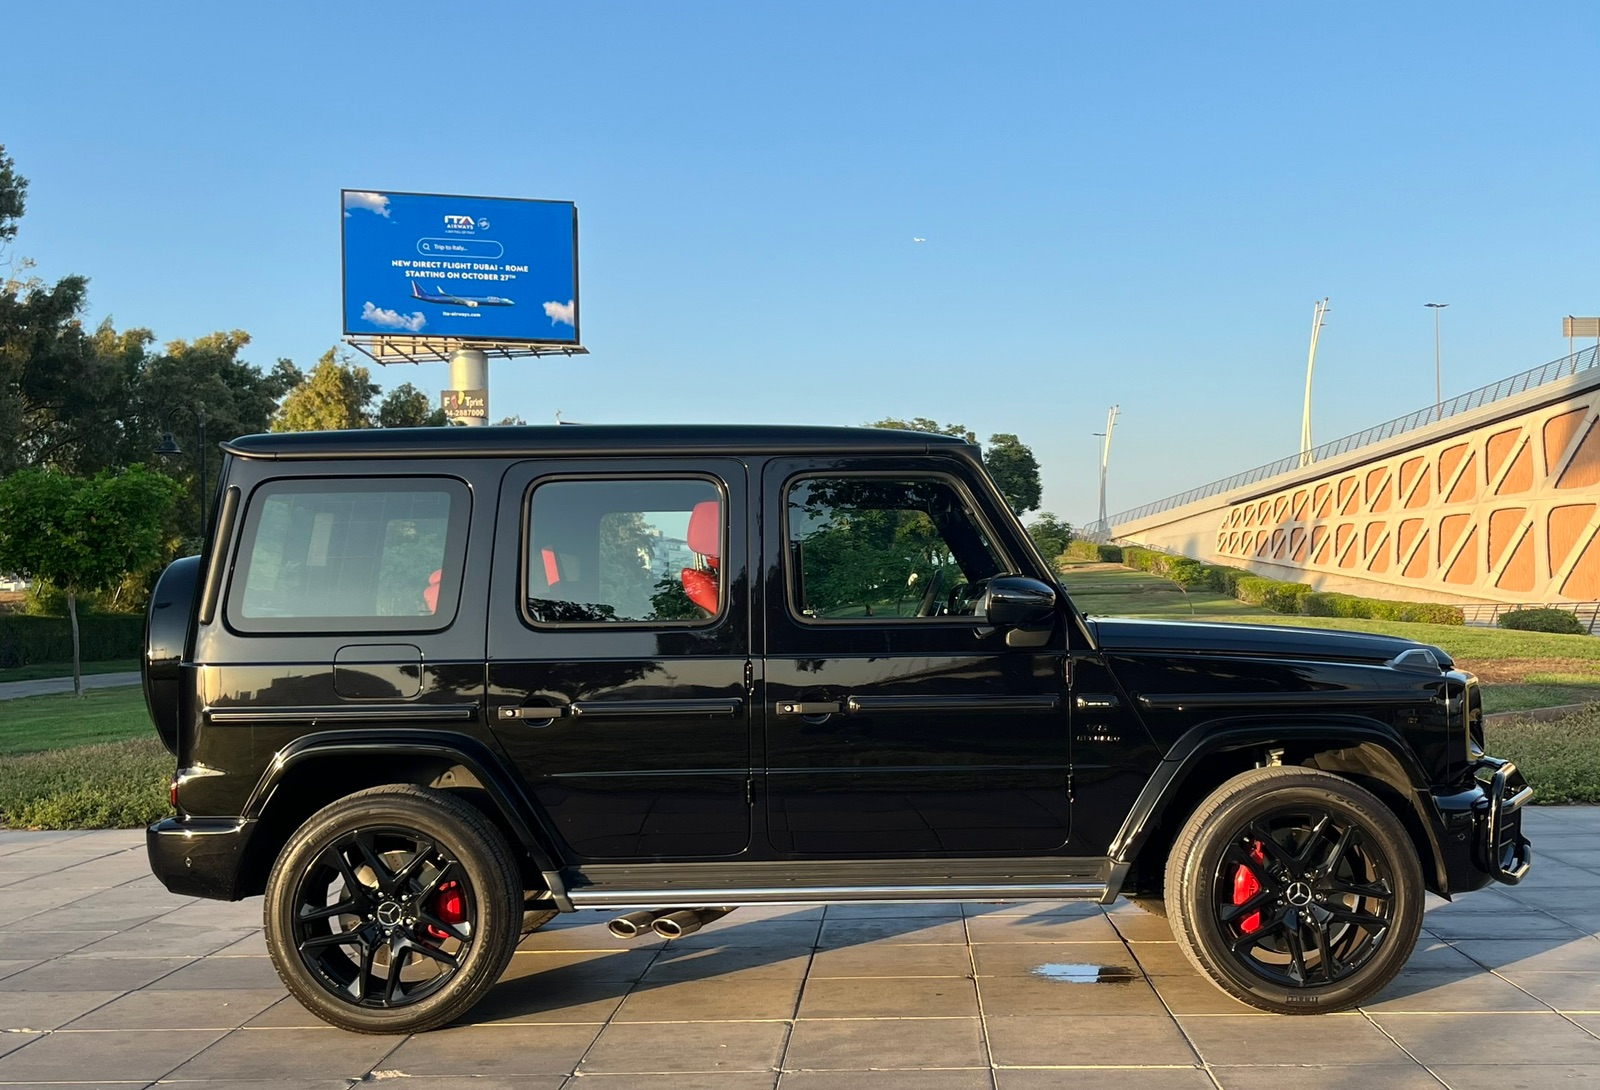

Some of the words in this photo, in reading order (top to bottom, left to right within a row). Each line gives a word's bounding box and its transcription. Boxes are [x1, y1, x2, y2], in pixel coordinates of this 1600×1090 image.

[444, 215, 475, 225] ITA
[433, 243, 445, 251] Trip
[443, 262, 471, 270] FLIGHT
[473, 263, 498, 271] DUBAI
[505, 264, 529, 272] ROME
[405, 270, 445, 278] STARTING
[461, 272, 499, 280] OCTOBER
